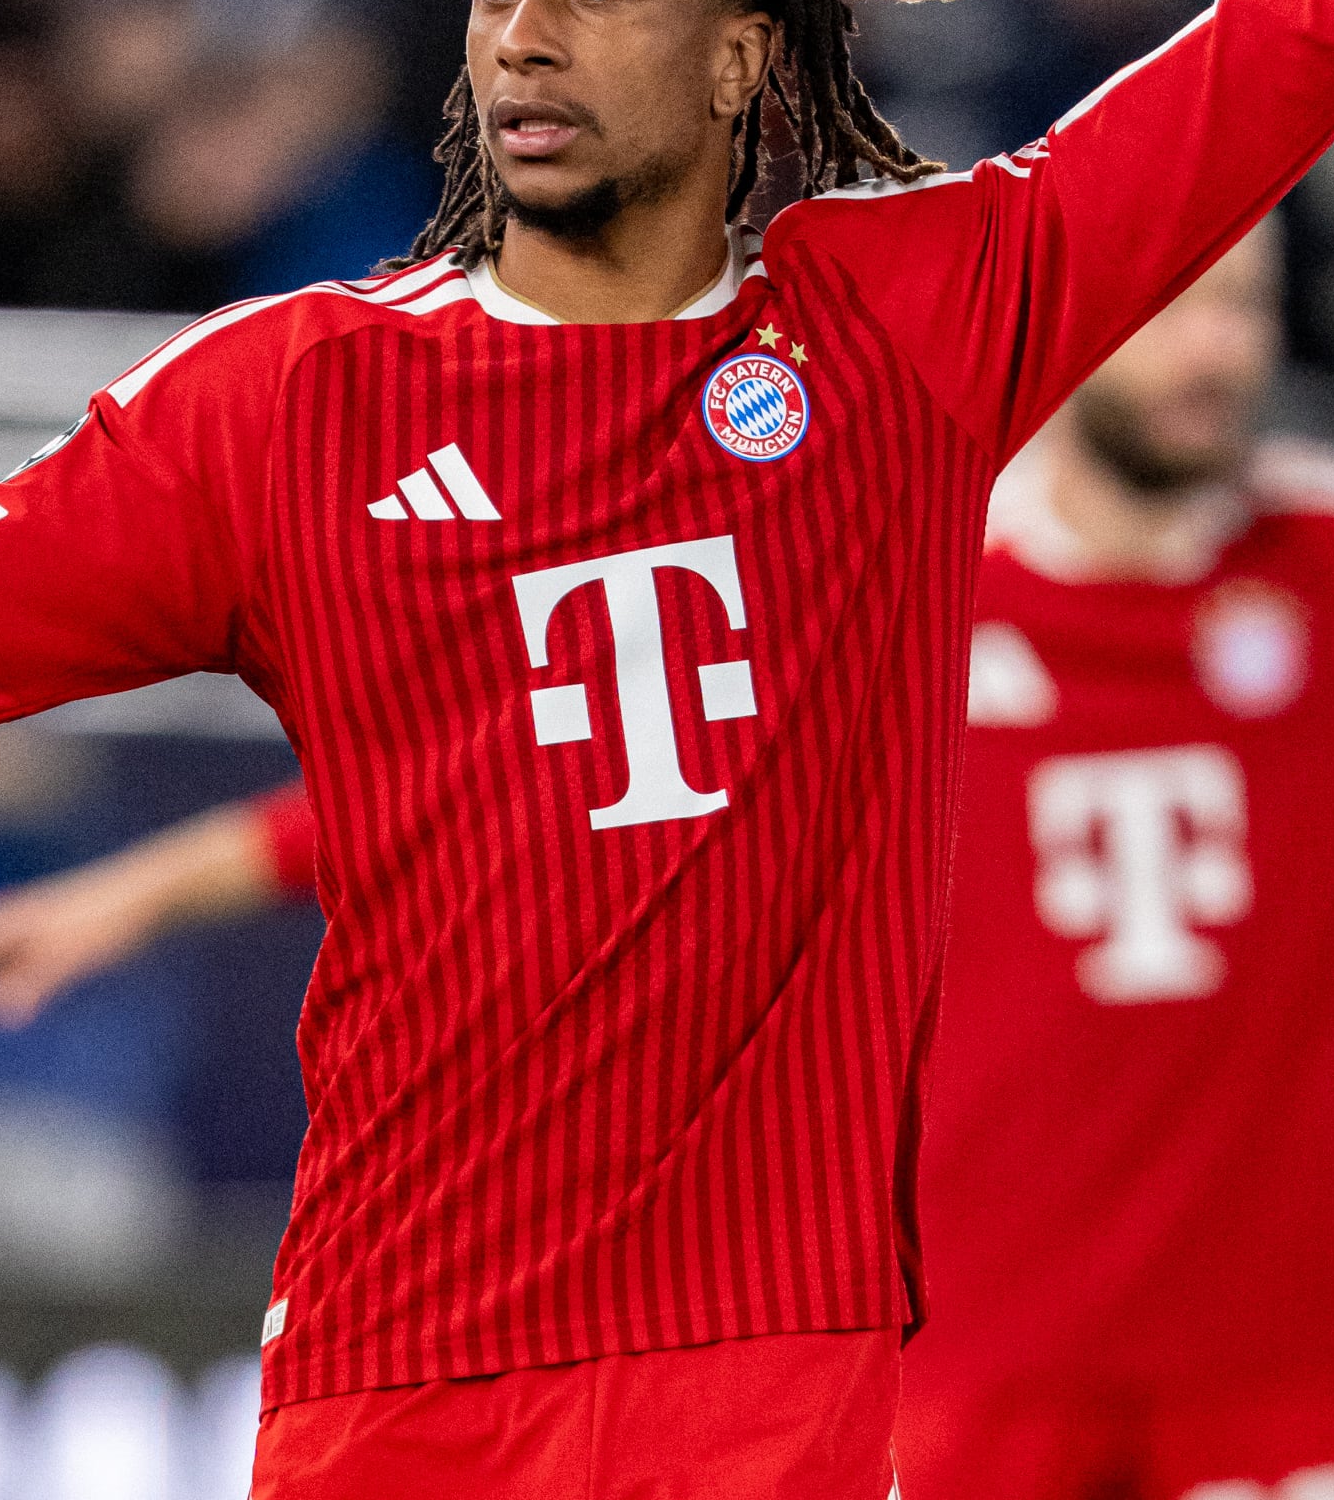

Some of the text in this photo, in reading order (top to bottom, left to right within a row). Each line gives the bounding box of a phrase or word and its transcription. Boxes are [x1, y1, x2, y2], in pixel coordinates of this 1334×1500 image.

[710, 362, 794, 410] FC BAYERN
[512, 534, 758, 831] T
